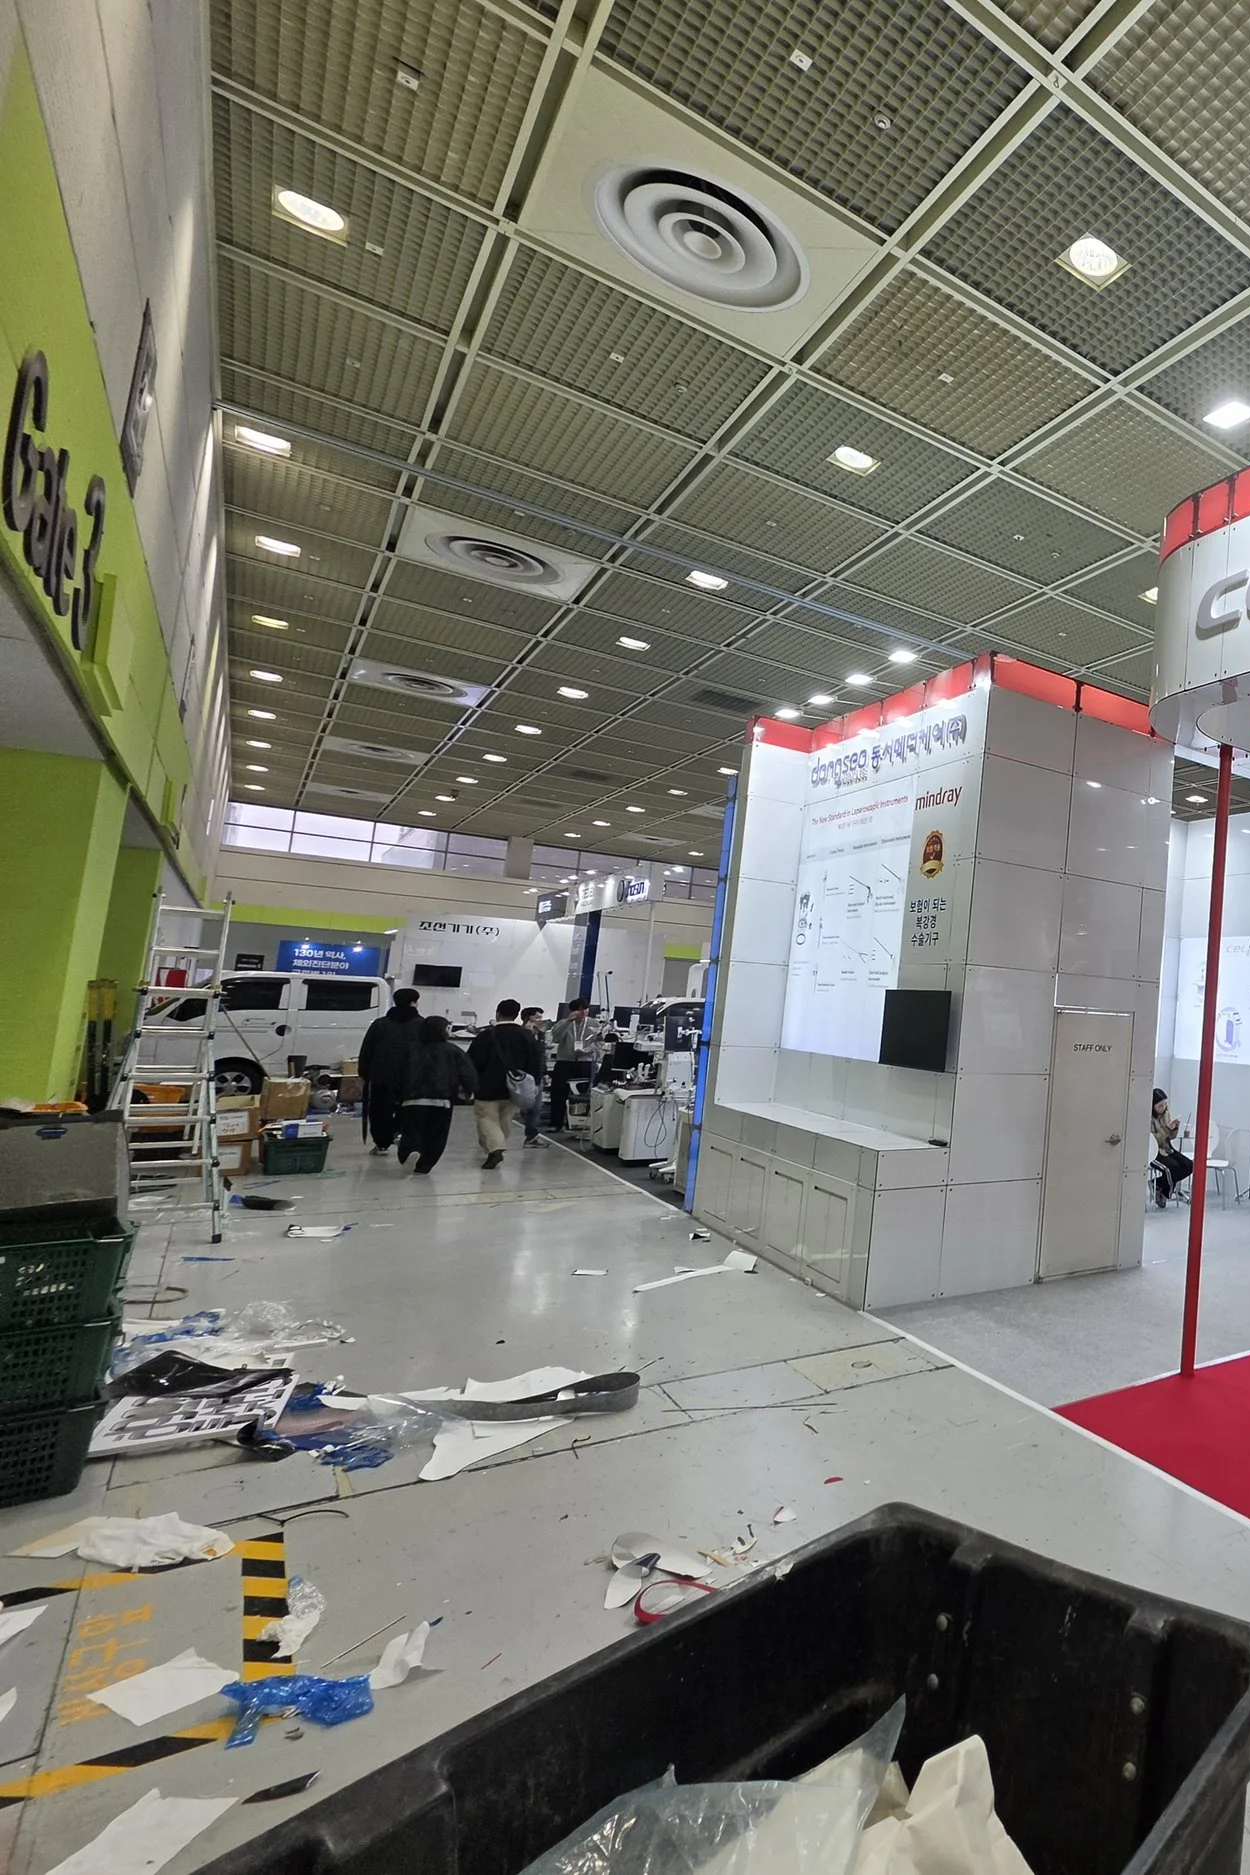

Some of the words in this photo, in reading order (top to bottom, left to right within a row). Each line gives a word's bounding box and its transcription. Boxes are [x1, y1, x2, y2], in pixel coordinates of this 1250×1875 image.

[71, 474, 106, 651] 3
[915, 786, 963, 811] mindray
[828, 811, 846, 822] Standard
[909, 898, 931, 913] 보험이
[932, 897, 947, 912] 되는
[915, 915, 937, 930] 복강경
[911, 932, 939, 947] 수술기구
[294, 948, 324, 959] 130년
[1073, 1043, 1094, 1052] STAFF
[1094, 1044, 1113, 1053] ONLY
